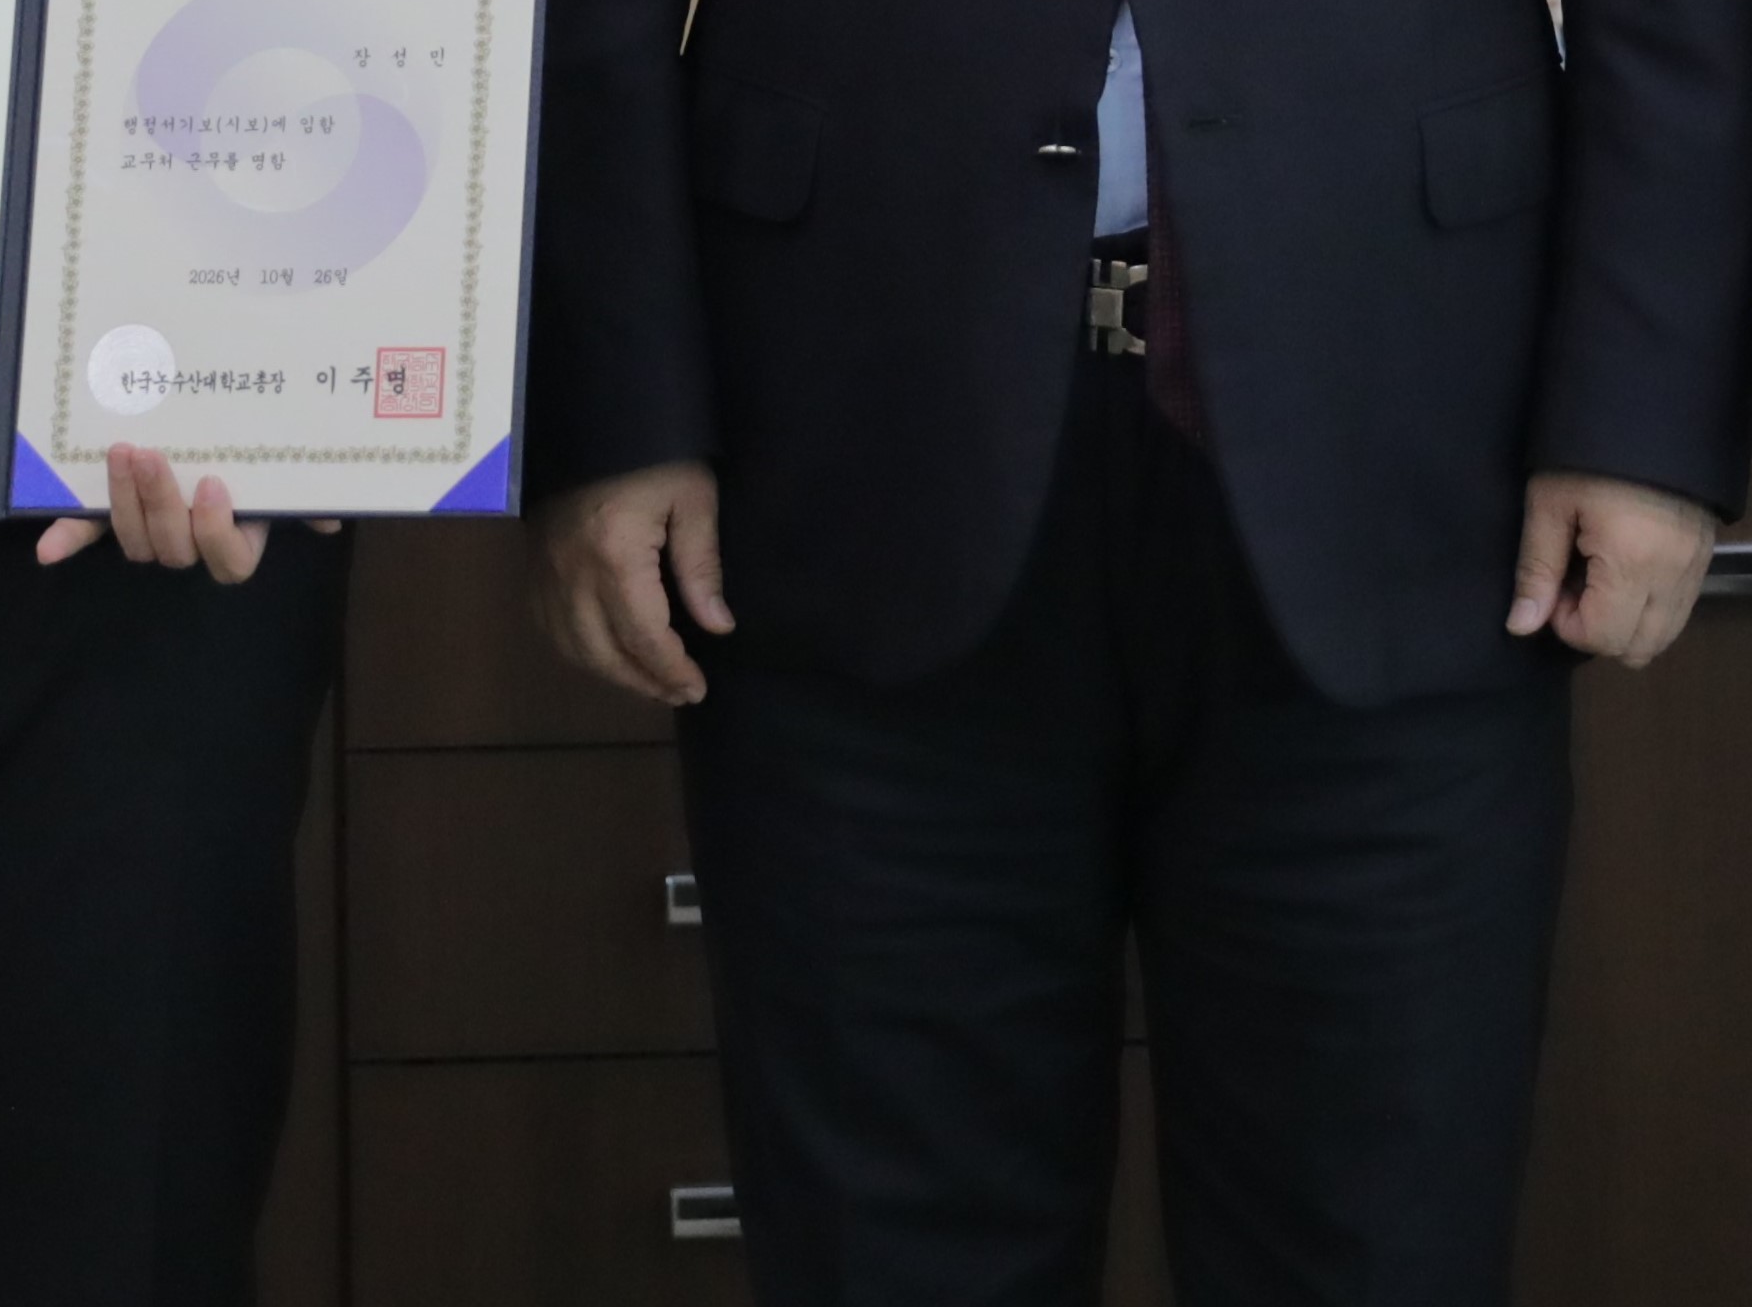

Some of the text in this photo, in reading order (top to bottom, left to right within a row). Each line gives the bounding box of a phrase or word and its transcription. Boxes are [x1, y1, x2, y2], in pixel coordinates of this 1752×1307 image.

[122, 114, 336, 137] 행정서기보(시보)에 임함
[120, 151, 287, 172] 교무처 근무를 명함
[188, 267, 348, 287] 2026년 10월 26일
[120, 369, 286, 395] 한국농수산대학교총장
